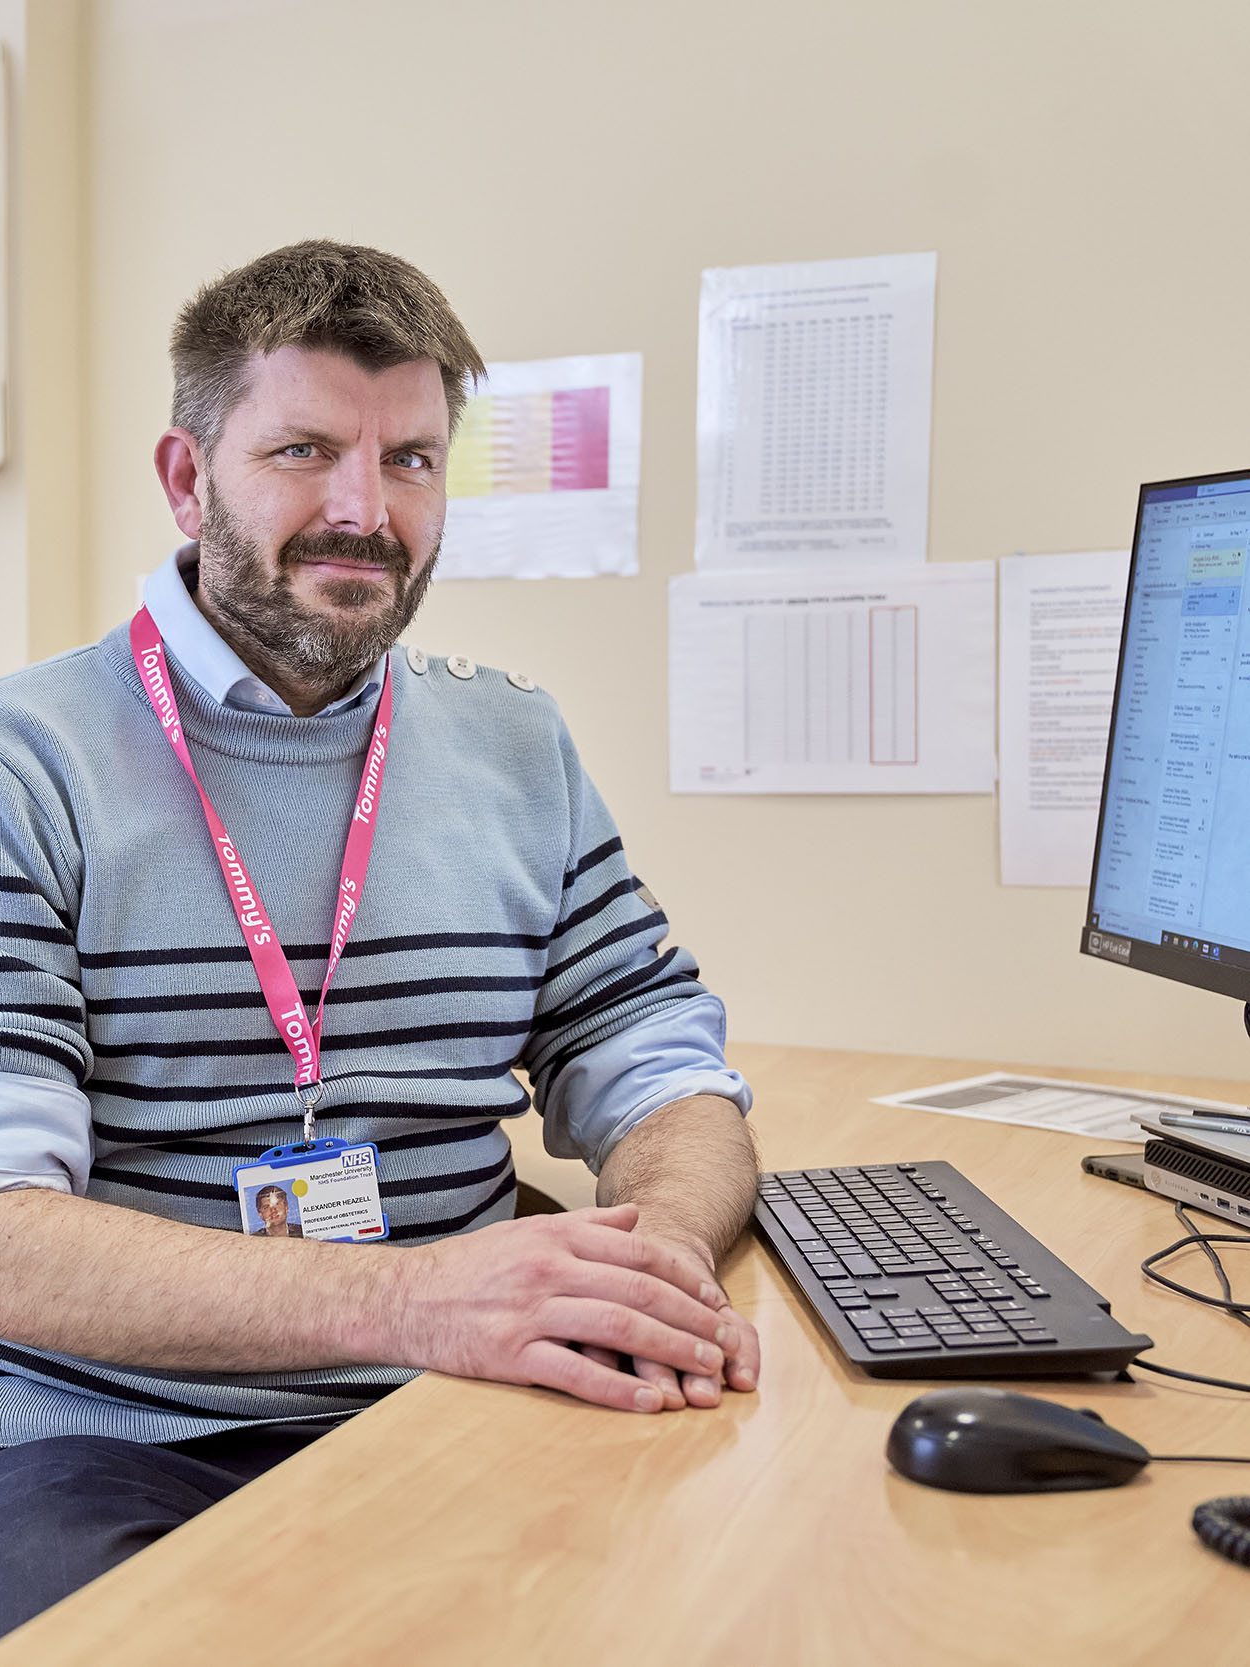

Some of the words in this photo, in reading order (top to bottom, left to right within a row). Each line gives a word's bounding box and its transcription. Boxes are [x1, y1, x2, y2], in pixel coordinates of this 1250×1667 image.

[141, 643, 180, 744] Tommy's
[353, 723, 387, 825] Tommy's
[217, 833, 271, 946] Tommy's
[342, 1152, 370, 1167] NHS
[310, 1171, 343, 1180] Manchester
[344, 1166, 372, 1174] University
[330, 1174, 359, 1183] Foundation
[303, 1201, 341, 1213] ALEXANDER
[342, 1195, 371, 1205] HEAZELL
[304, 1216, 333, 1224] PROFESSOR
[339, 1209, 368, 1218] OBSTETRICS
